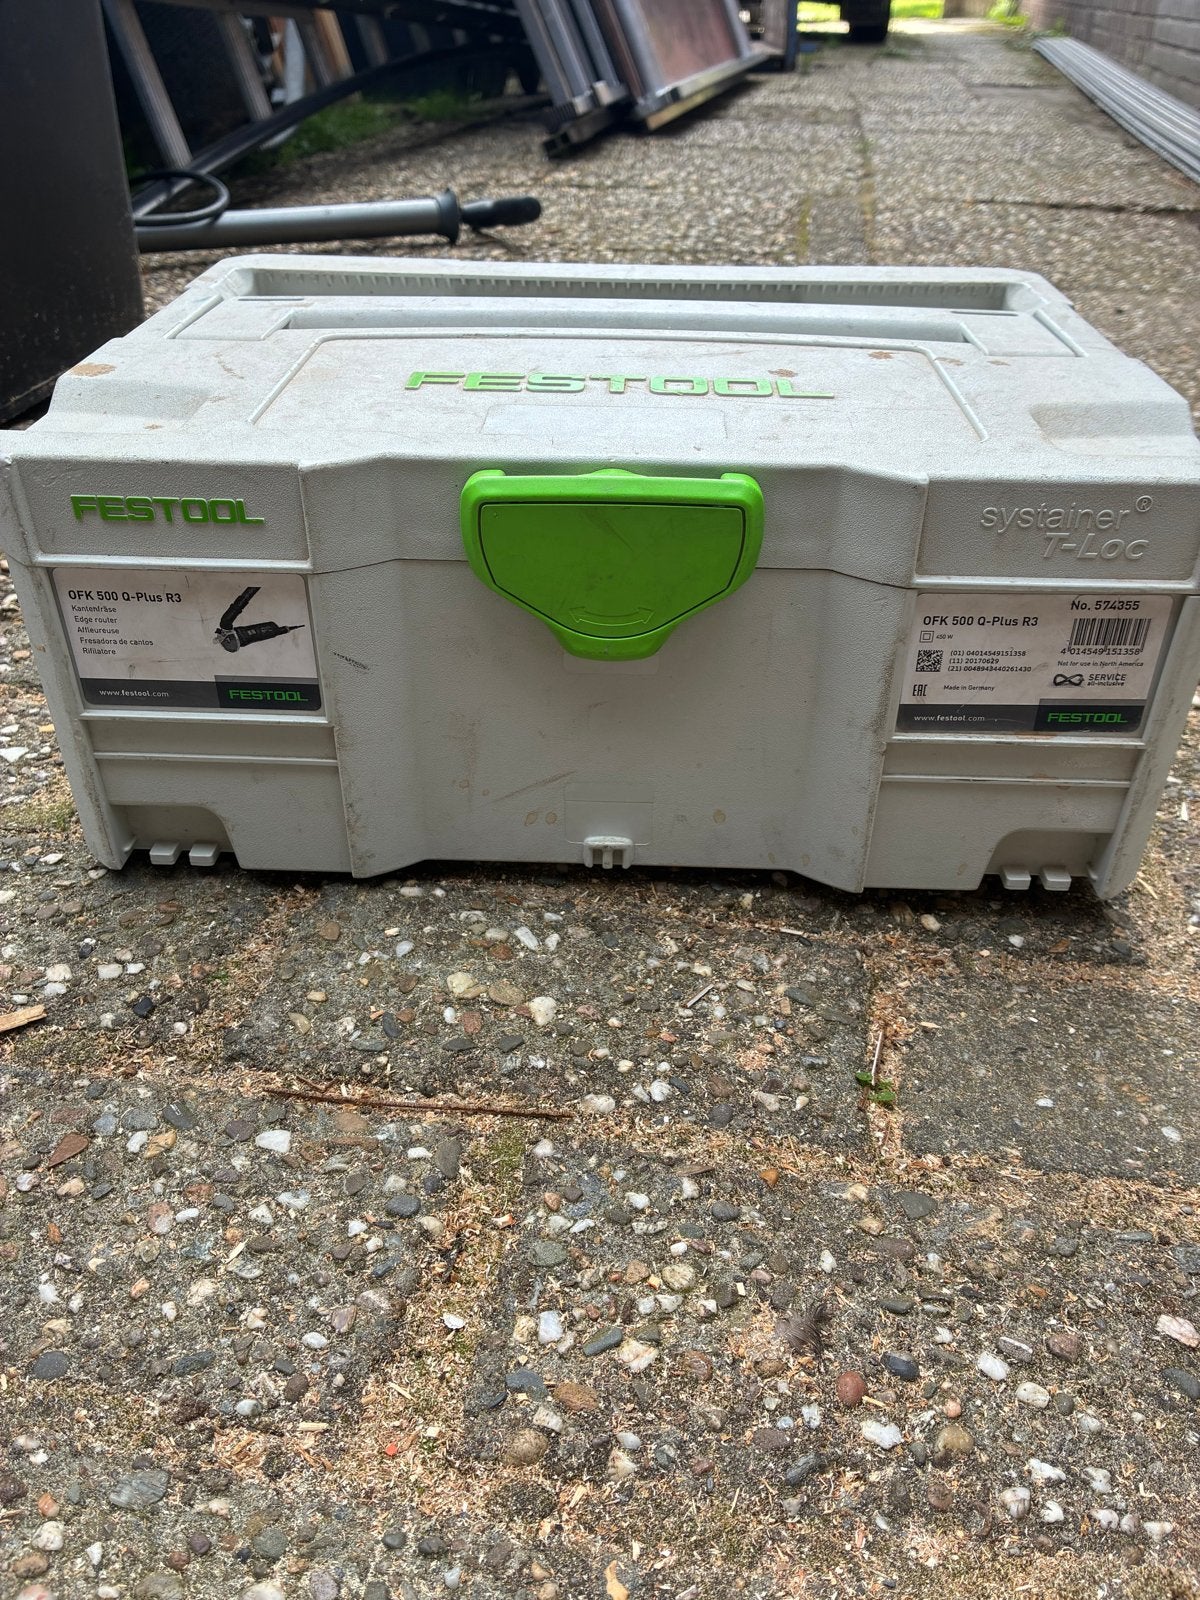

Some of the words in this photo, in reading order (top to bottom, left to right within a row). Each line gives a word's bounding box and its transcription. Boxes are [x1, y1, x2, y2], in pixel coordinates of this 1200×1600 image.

[404, 371, 835, 398] FESTOOL
[70, 494, 265, 524] FESTOOL
[980, 502, 1131, 533] systainer
[68, 589, 94, 601] OFK
[97, 590, 118, 601] 500
[122, 591, 163, 603] Q-Plus
[166, 592, 182, 603] R3
[71, 604, 117, 613] Kantenfräse
[1070, 600, 1092, 611] No.
[1094, 600, 1140, 611] 574355
[74, 615, 93, 624] Edge
[923, 615, 949, 626] OFK
[951, 616, 974, 626] 500
[977, 616, 1018, 627] Q-Plus
[1022, 616, 1039, 627] R3
[80, 636, 118, 645] Fresadora
[129, 638, 154, 646] cantos
[82, 647, 117, 655] Rifilatore
[965, 657, 1000, 665] 20170629
[1099, 660, 1118, 668] North
[1088, 673, 1127, 681] SERVICE
[99, 688, 170, 698] www.festool.com
[967, 684, 996, 692] Germany
[228, 689, 309, 702] FESTOOL
[913, 713, 985, 722] www.festool.com
[1047, 712, 1129, 723] FESTOOL
